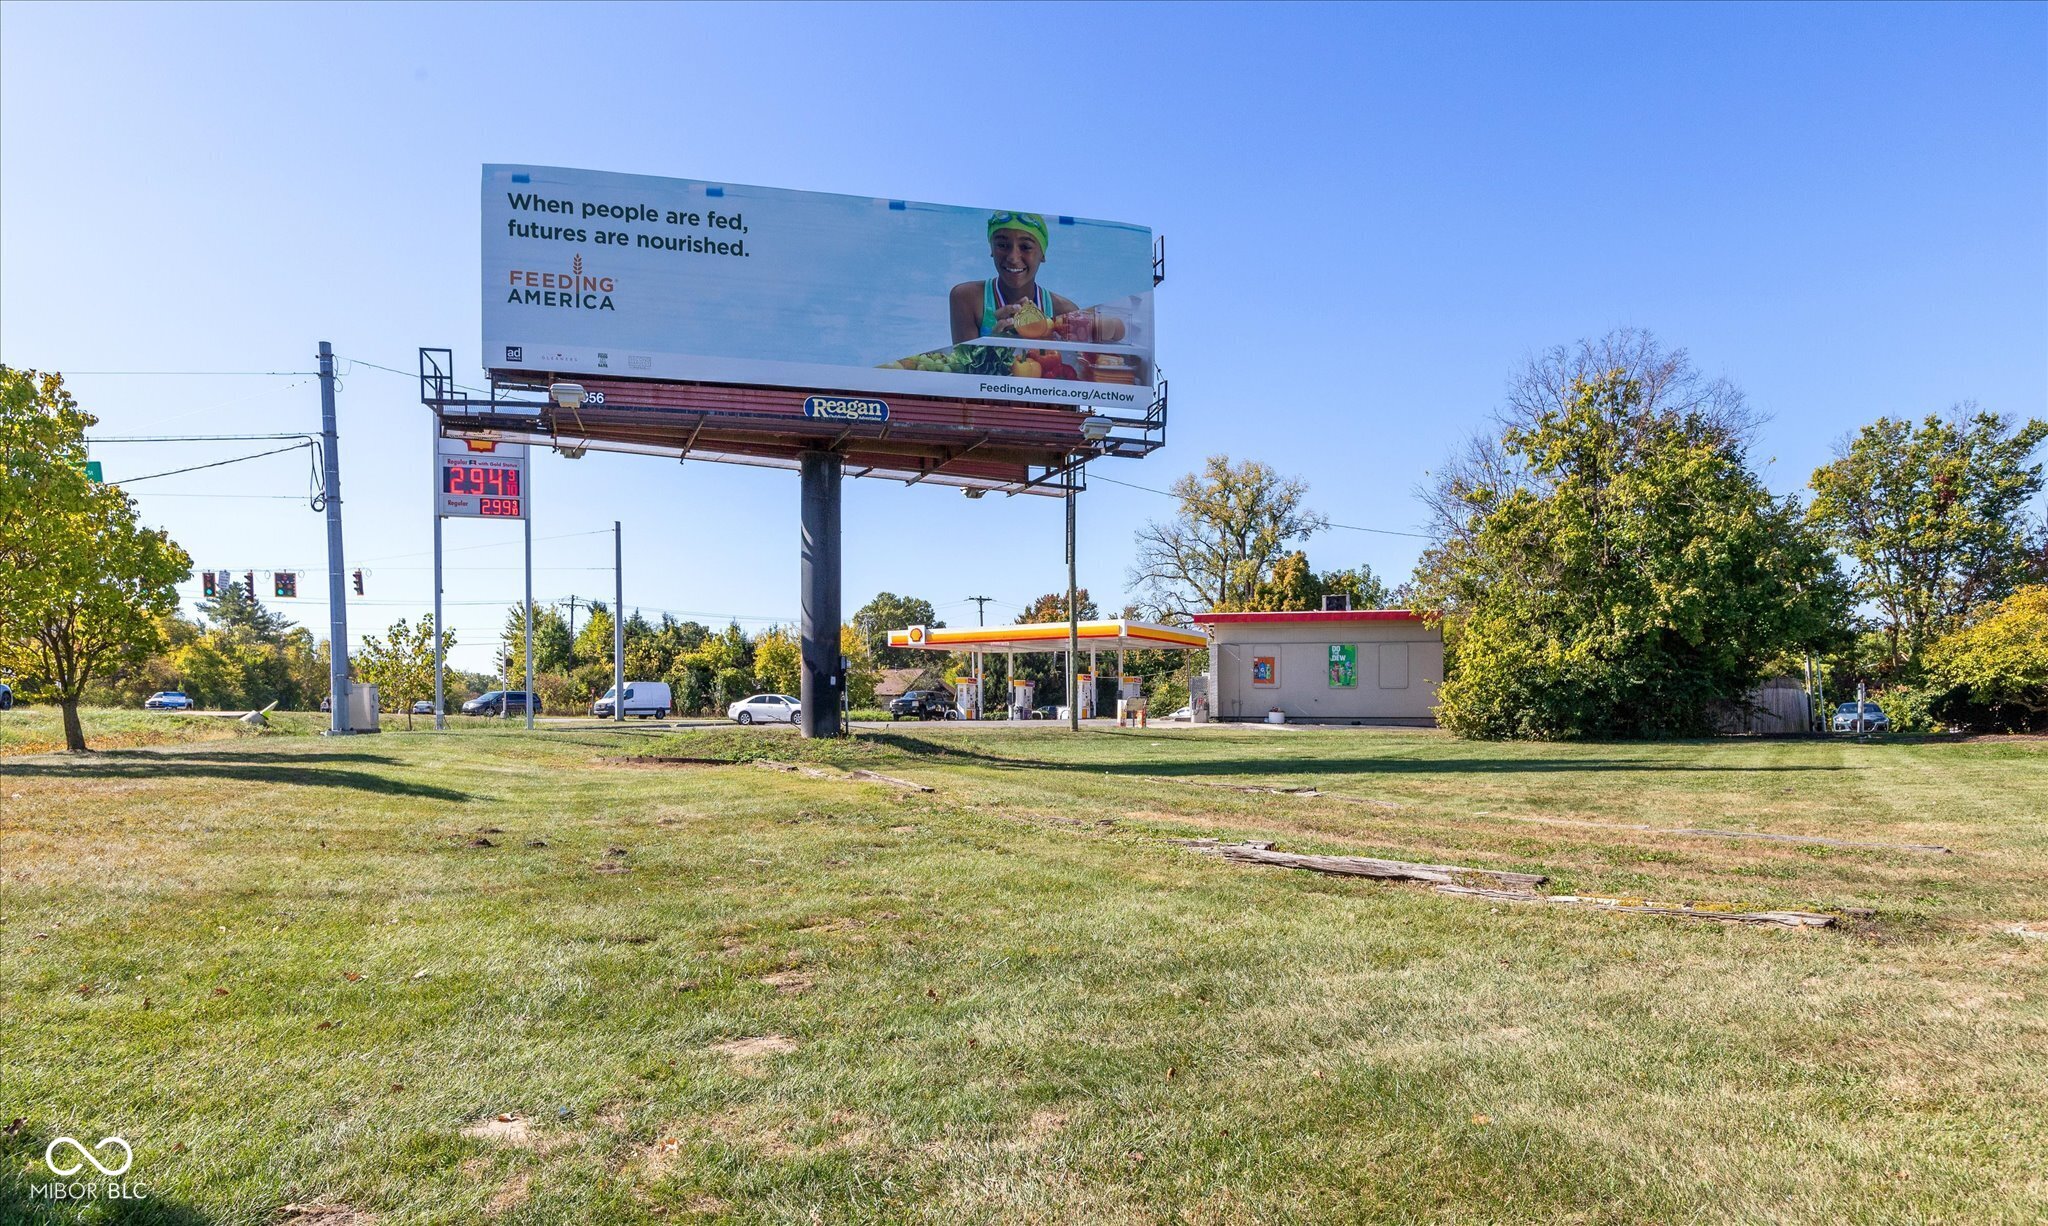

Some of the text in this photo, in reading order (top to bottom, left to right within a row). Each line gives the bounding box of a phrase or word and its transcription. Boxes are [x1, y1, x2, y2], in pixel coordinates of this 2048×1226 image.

[507, 192, 748, 234] When people are fed,
[508, 219, 750, 257] futures are nourished.
[510, 270, 614, 294] FEEDING
[507, 288, 616, 311] AMERICA
[507, 347, 521, 357] ad
[979, 383, 1135, 402] FeedingAmerica.org/ActNow
[812, 398, 882, 419] Reagan
[450, 467, 503, 496] 2.94
[447, 499, 469, 507] Regular
